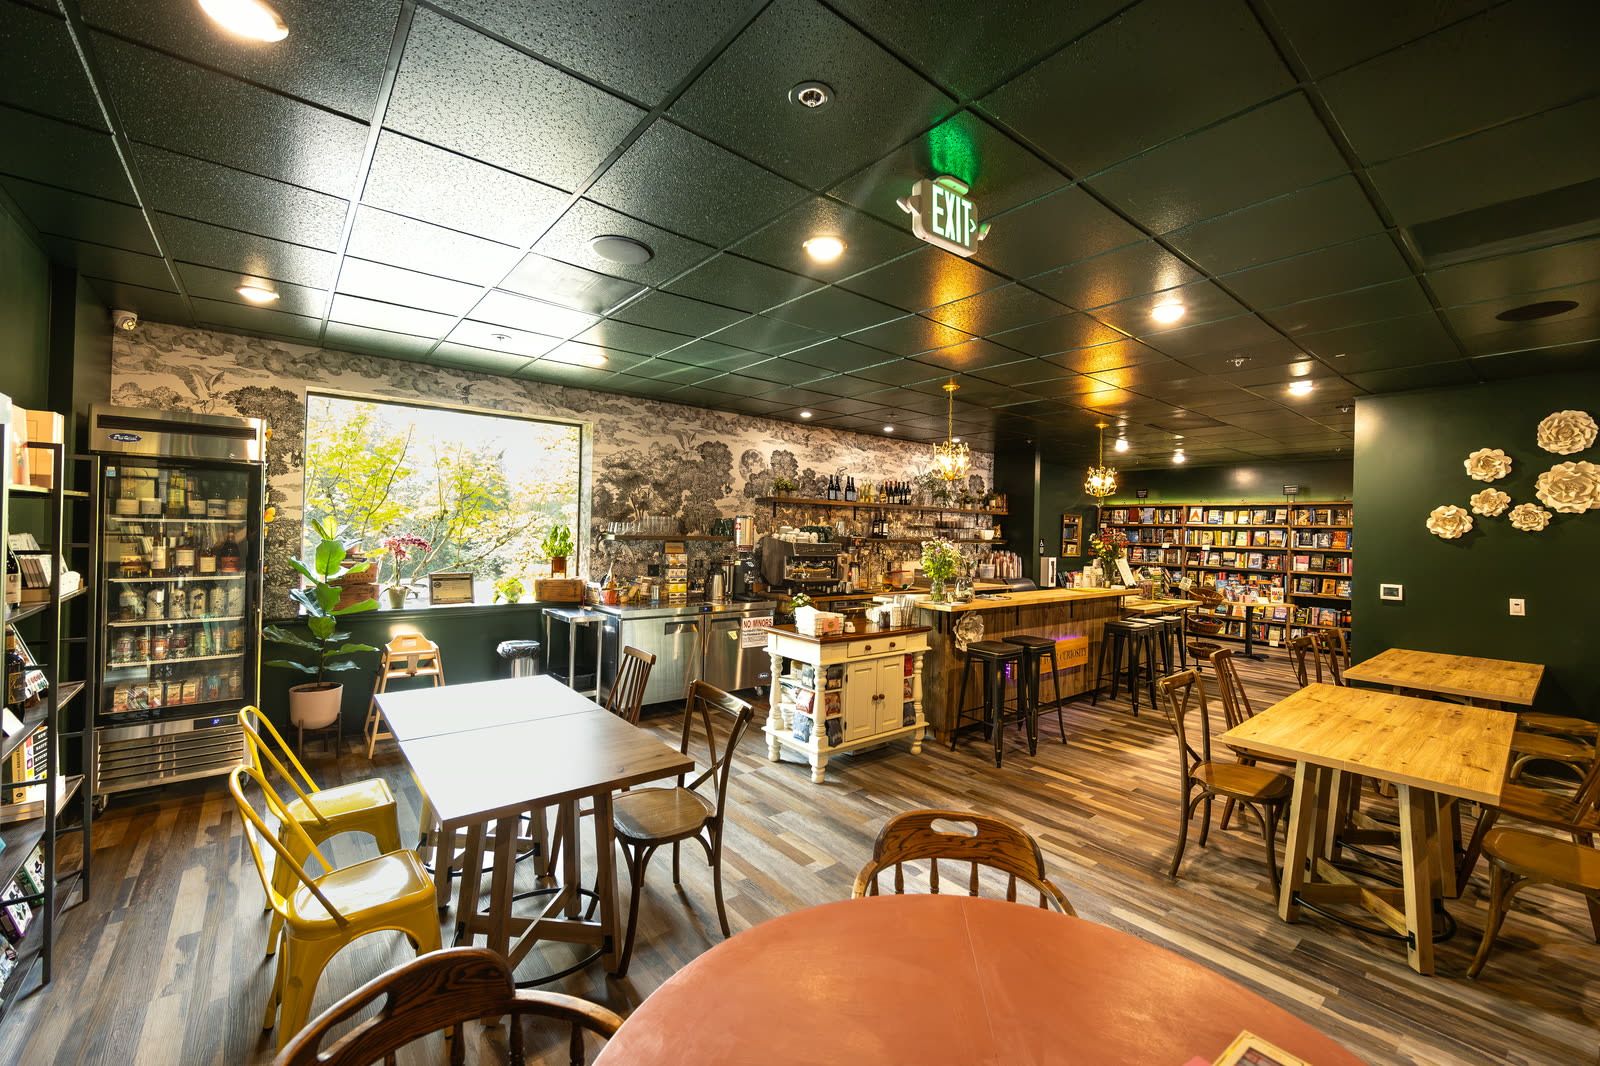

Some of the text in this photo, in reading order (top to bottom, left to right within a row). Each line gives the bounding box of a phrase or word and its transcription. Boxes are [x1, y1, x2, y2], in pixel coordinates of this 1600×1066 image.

[932, 183, 972, 247] EXIT
[743, 618, 772, 628] NO MINORS
